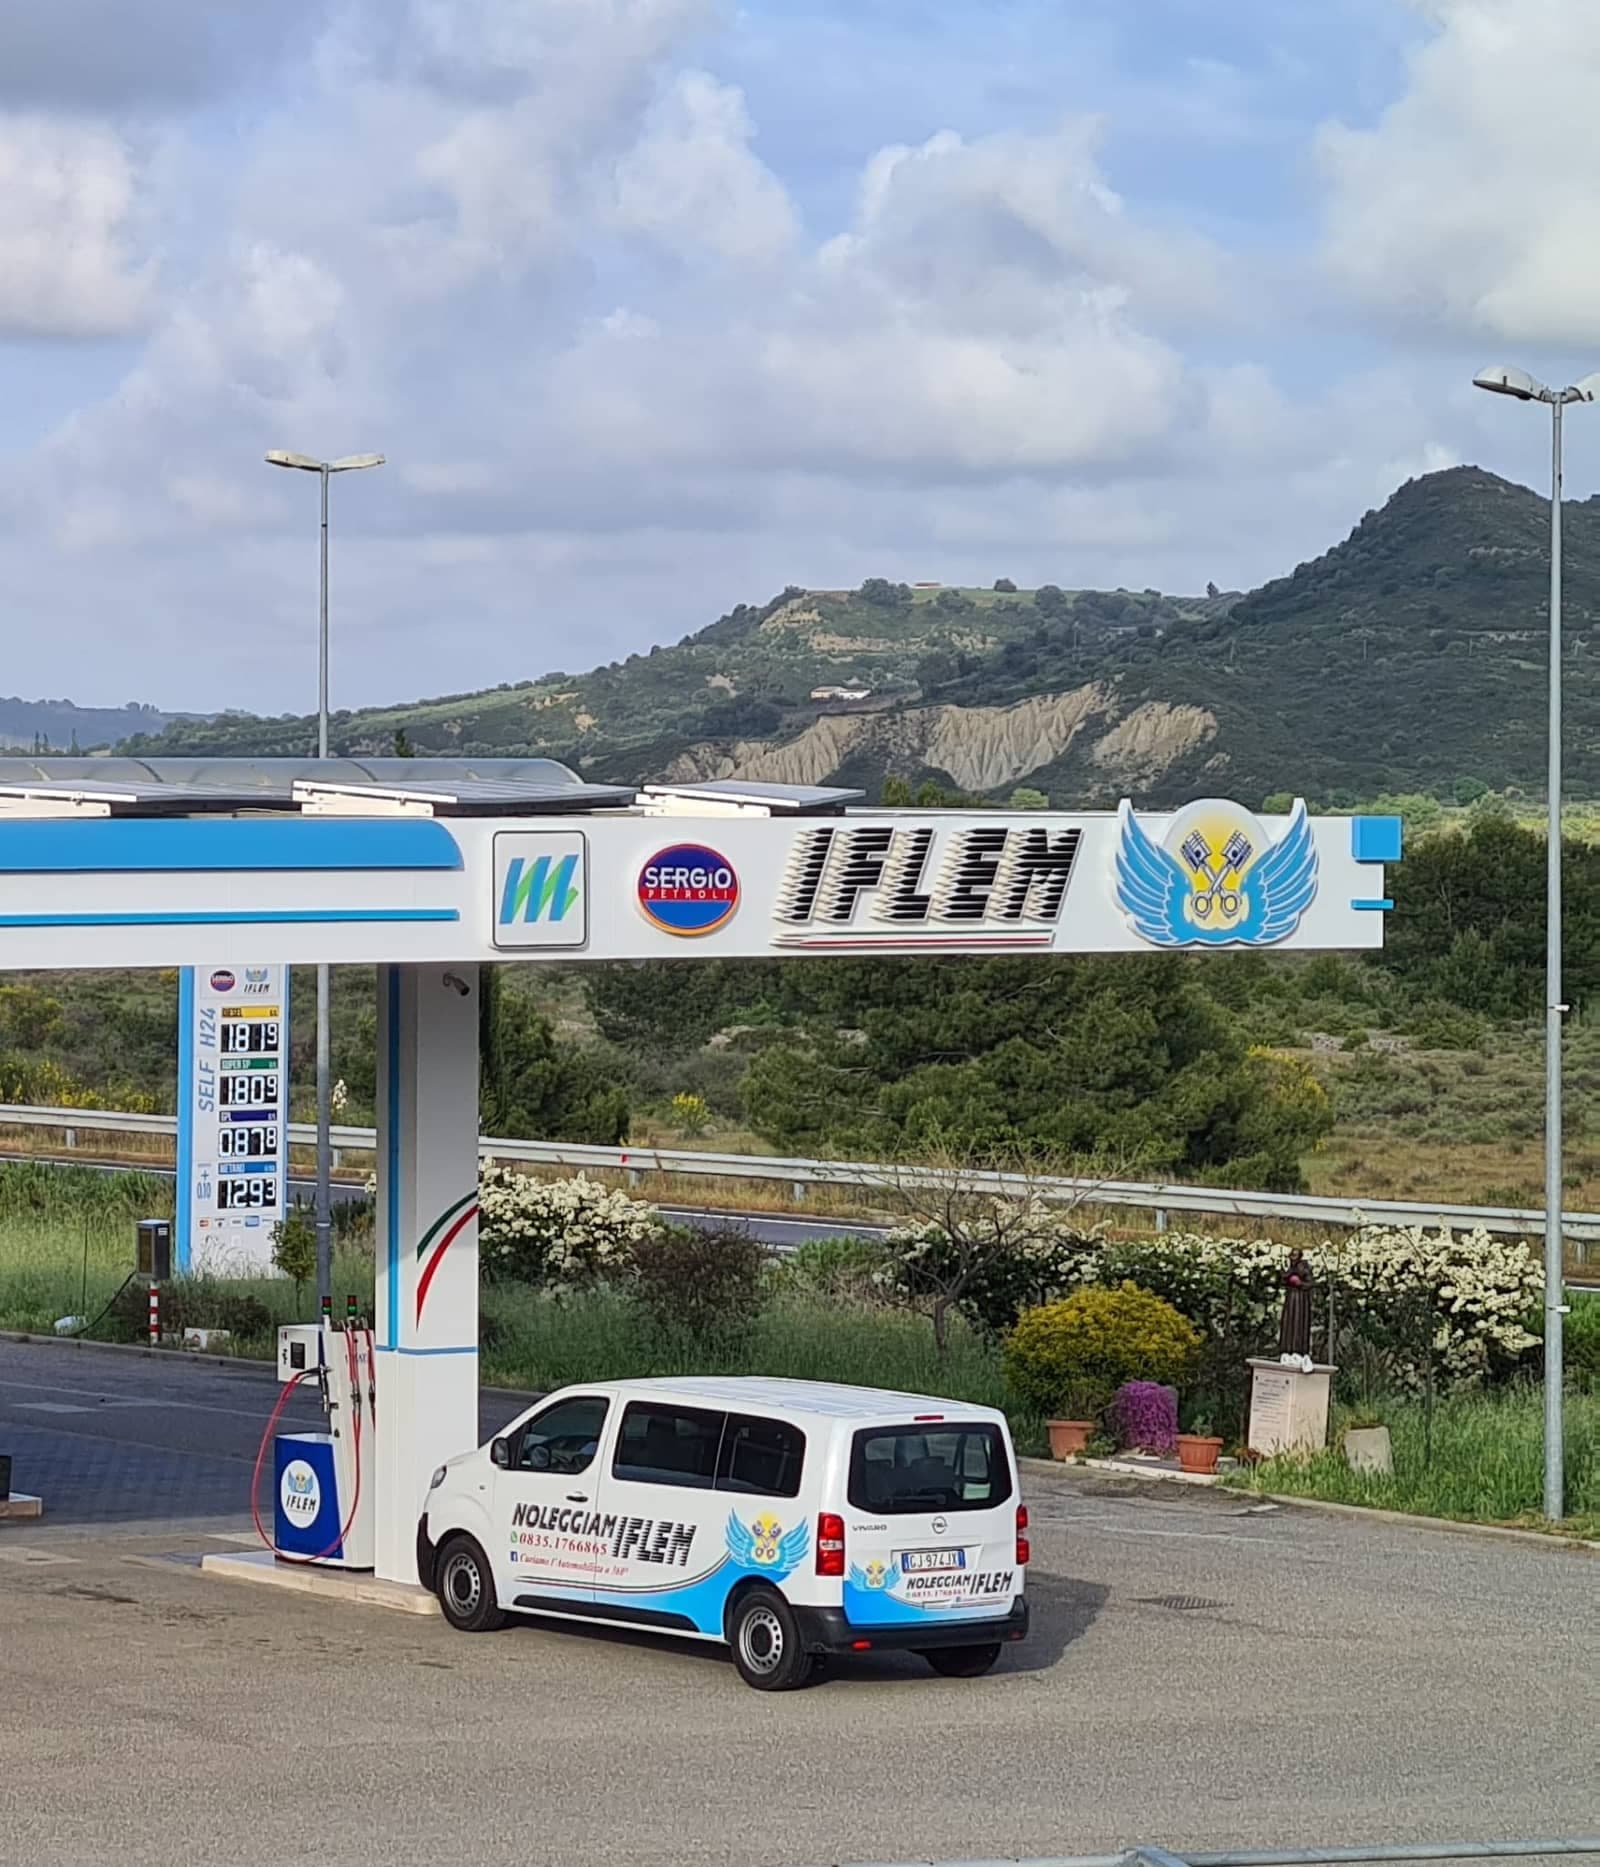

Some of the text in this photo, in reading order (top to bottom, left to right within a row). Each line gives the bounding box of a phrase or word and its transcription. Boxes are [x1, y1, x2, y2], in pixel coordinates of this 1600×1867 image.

[772, 827, 1082, 922] IFLEM
[648, 890, 728, 899] PETROLI
[199, 1008, 216, 1112] SELF H24
[286, 1494, 316, 1511] IFLEM
[512, 1502, 697, 1566] NOLEGGIAM IFLEM
[519, 1532, 608, 1556] 0835.1766865
[970, 1571, 1013, 1595] IFLEM
